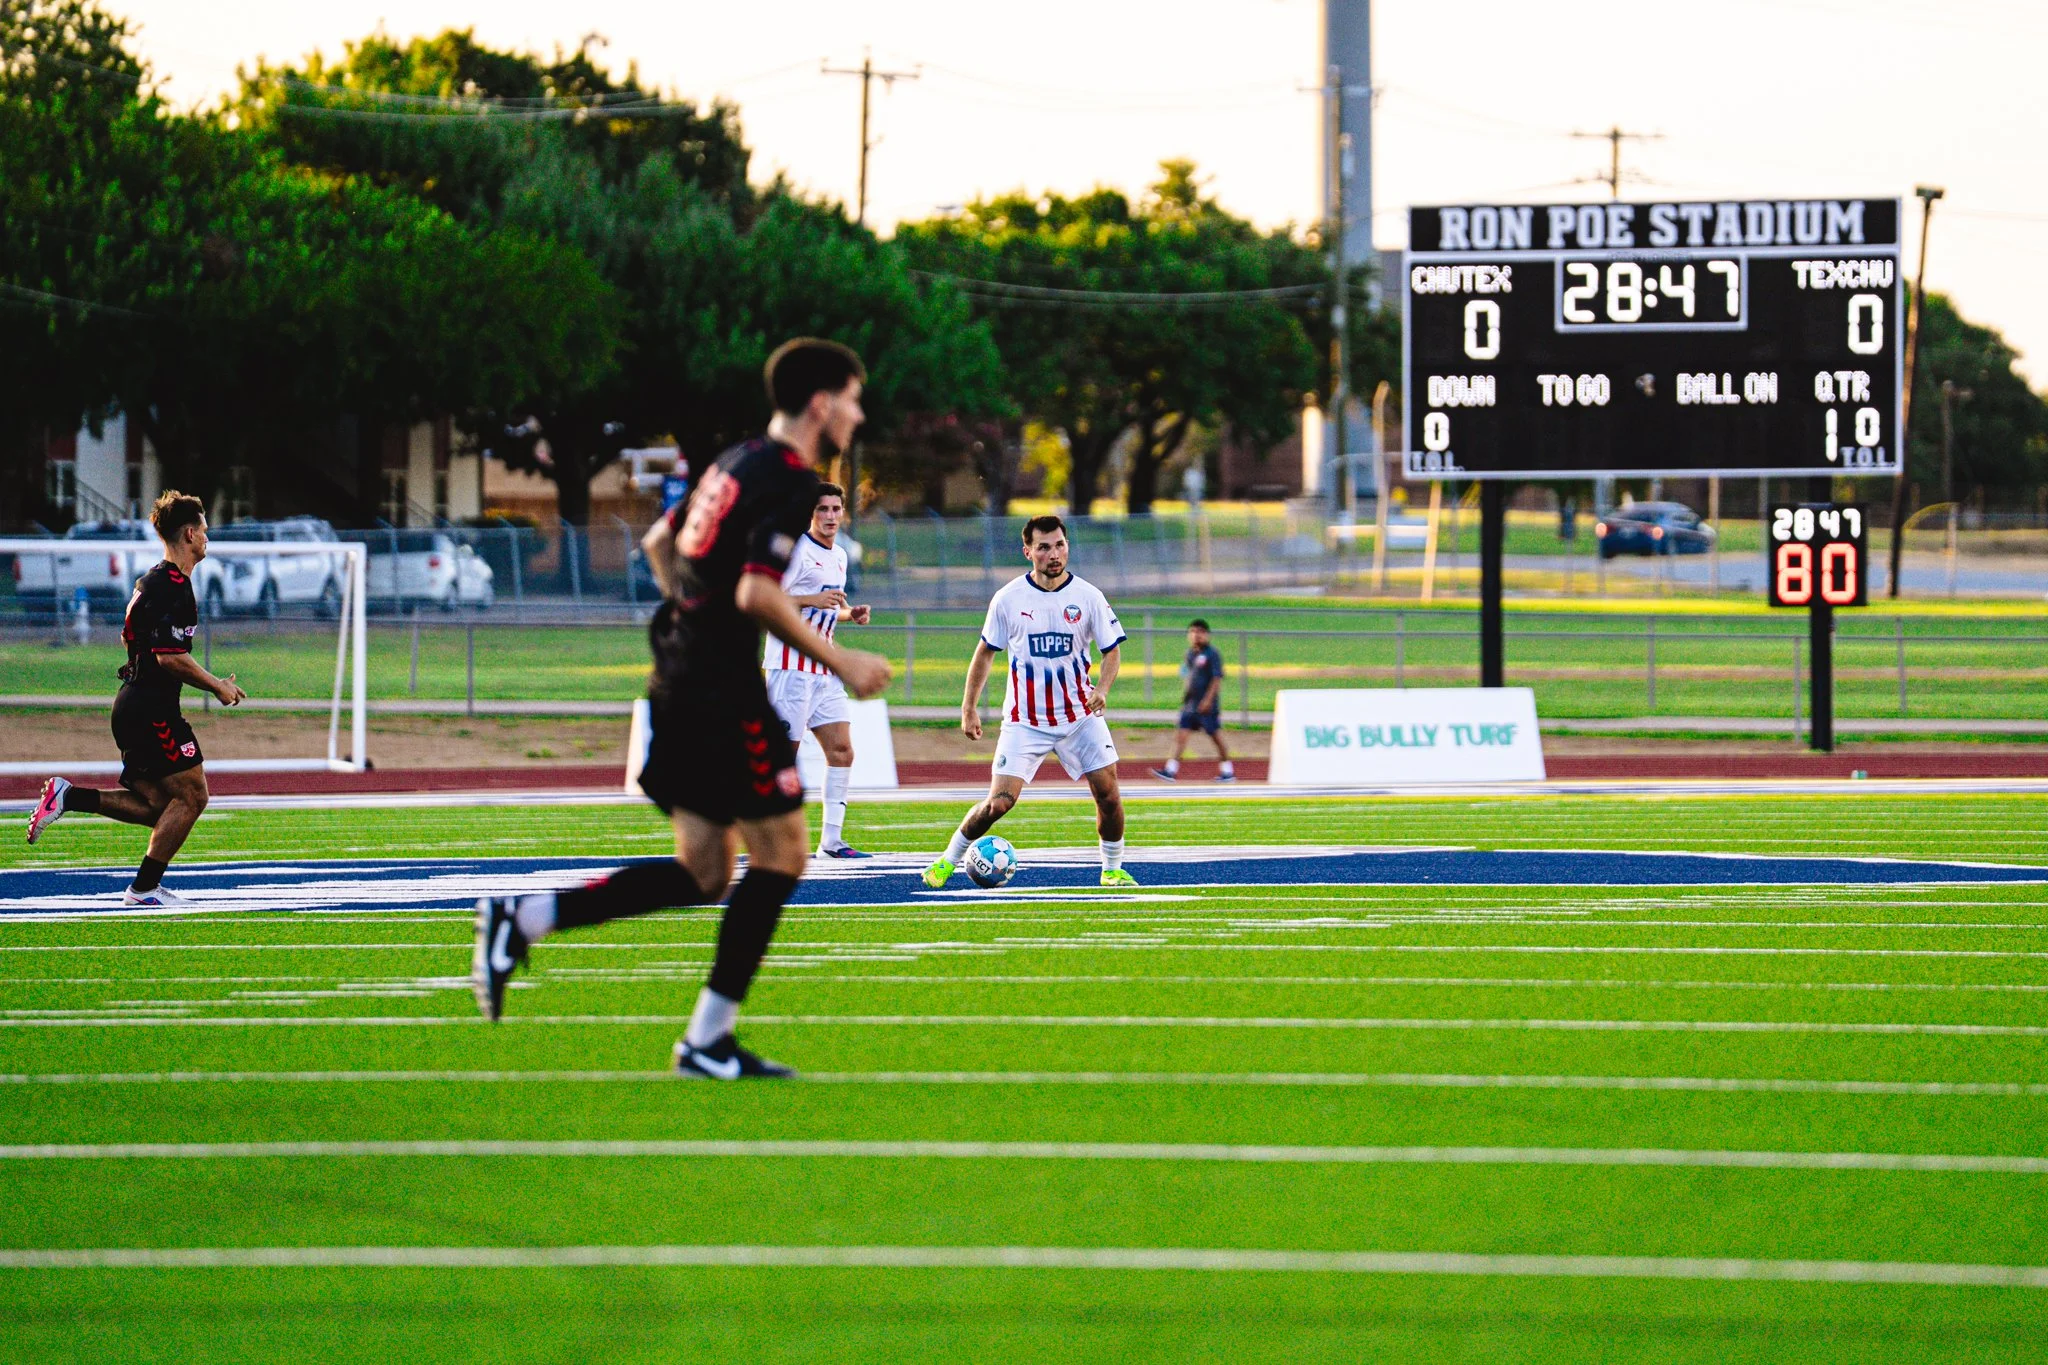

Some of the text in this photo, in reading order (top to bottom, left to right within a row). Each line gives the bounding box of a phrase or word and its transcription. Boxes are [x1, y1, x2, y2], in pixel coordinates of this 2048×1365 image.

[1439, 200, 1865, 249] RON POE STADIUM
[1563, 260, 1739, 322] 28:47
[1464, 299, 1501, 360] 0
[1848, 293, 1884, 355] 0
[1427, 375, 1496, 408] DOWN
[1676, 371, 1778, 405] BALL ON
[1814, 370, 1871, 403] QTR
[1424, 411, 1450, 452] 0
[1777, 542, 1857, 605] 80
[1304, 722, 1518, 748] BIG BULLY TURF
